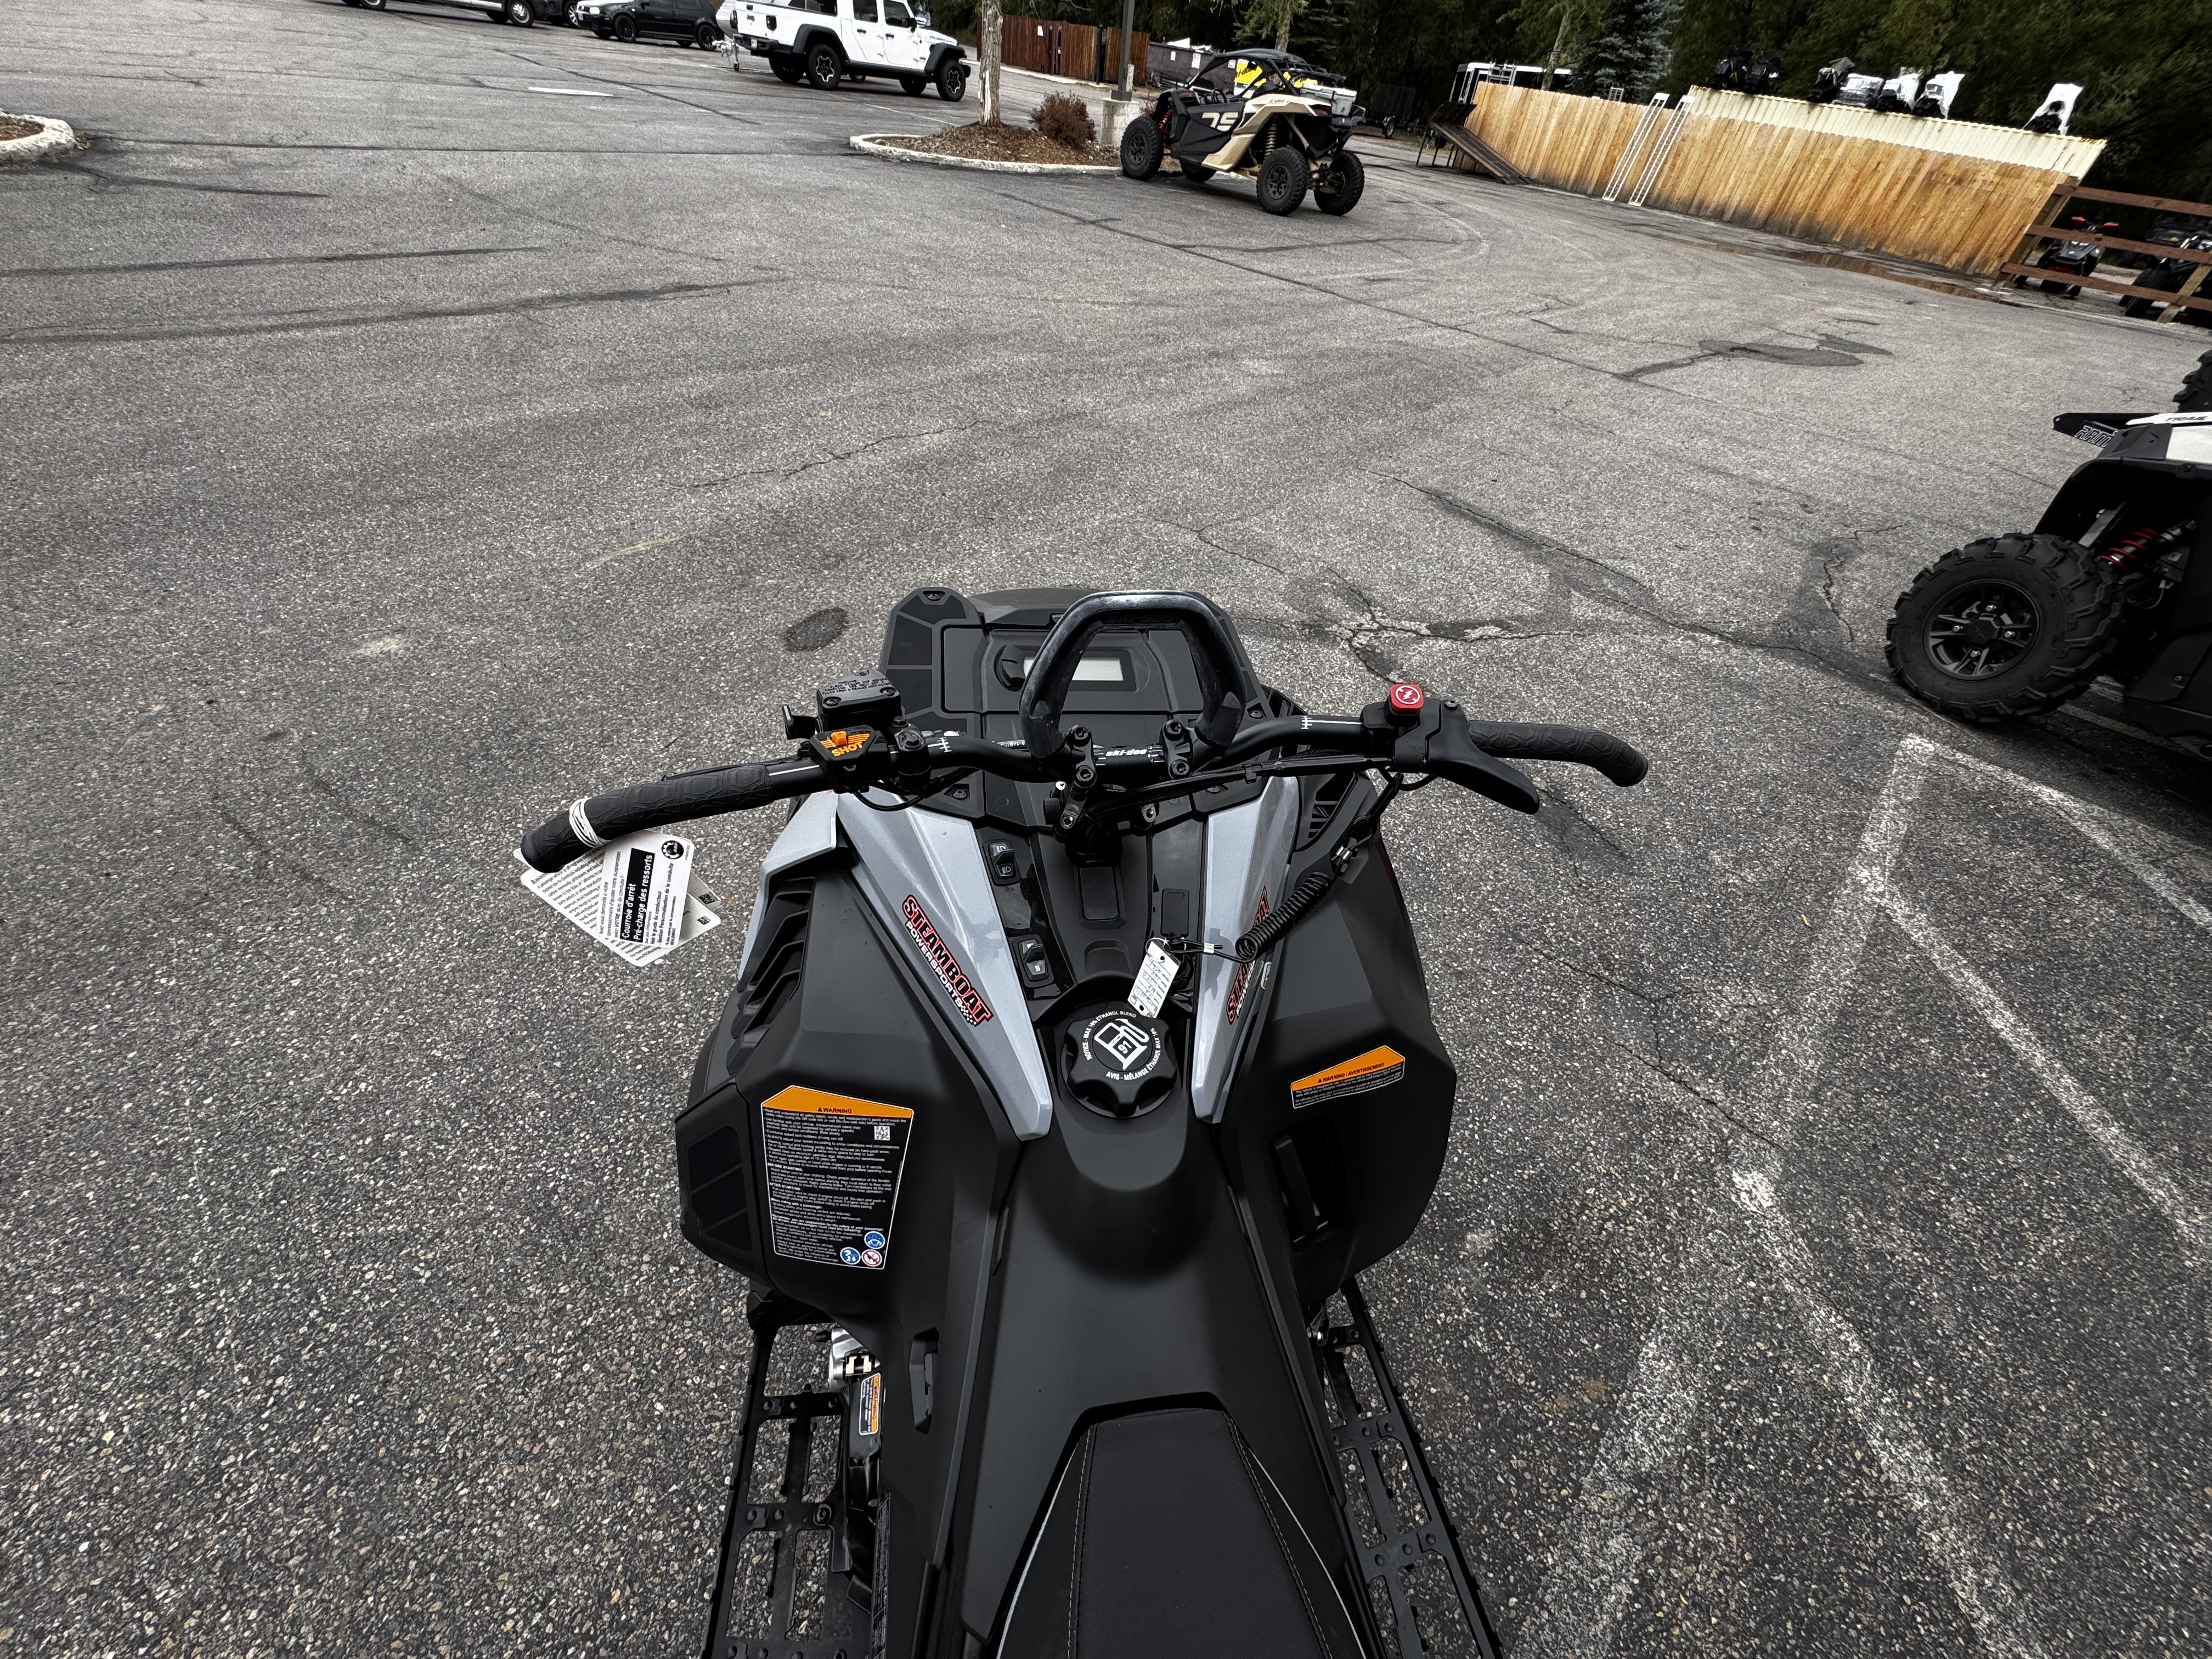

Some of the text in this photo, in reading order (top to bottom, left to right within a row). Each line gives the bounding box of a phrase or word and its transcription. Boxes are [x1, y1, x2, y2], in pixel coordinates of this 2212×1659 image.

[832, 741, 863, 757] SHOT
[1105, 748, 1147, 757] ski-doo
[625, 883, 636, 907] d'arrêt
[633, 854, 652, 940] Pré-charge des ressorts
[902, 894, 994, 1023] STEAMBOAT
[906, 921, 963, 1008] POWERSPORTS
[1096, 1011, 1119, 1022] ETHANOL
[1083, 1028, 1092, 1038] MAX
[1082, 1041, 1092, 1060] NOTICE
[1118, 1040, 1132, 1054] 91
[1105, 1071, 1120, 1080] AVIS
[1124, 1068, 1149, 1081] MÉLANGE
[1146, 1049, 1161, 1071] ÉTHANOL
[1323, 1073, 1345, 1082] WARNING
[1348, 1062, 1385, 1076] AVERTISSEMENT
